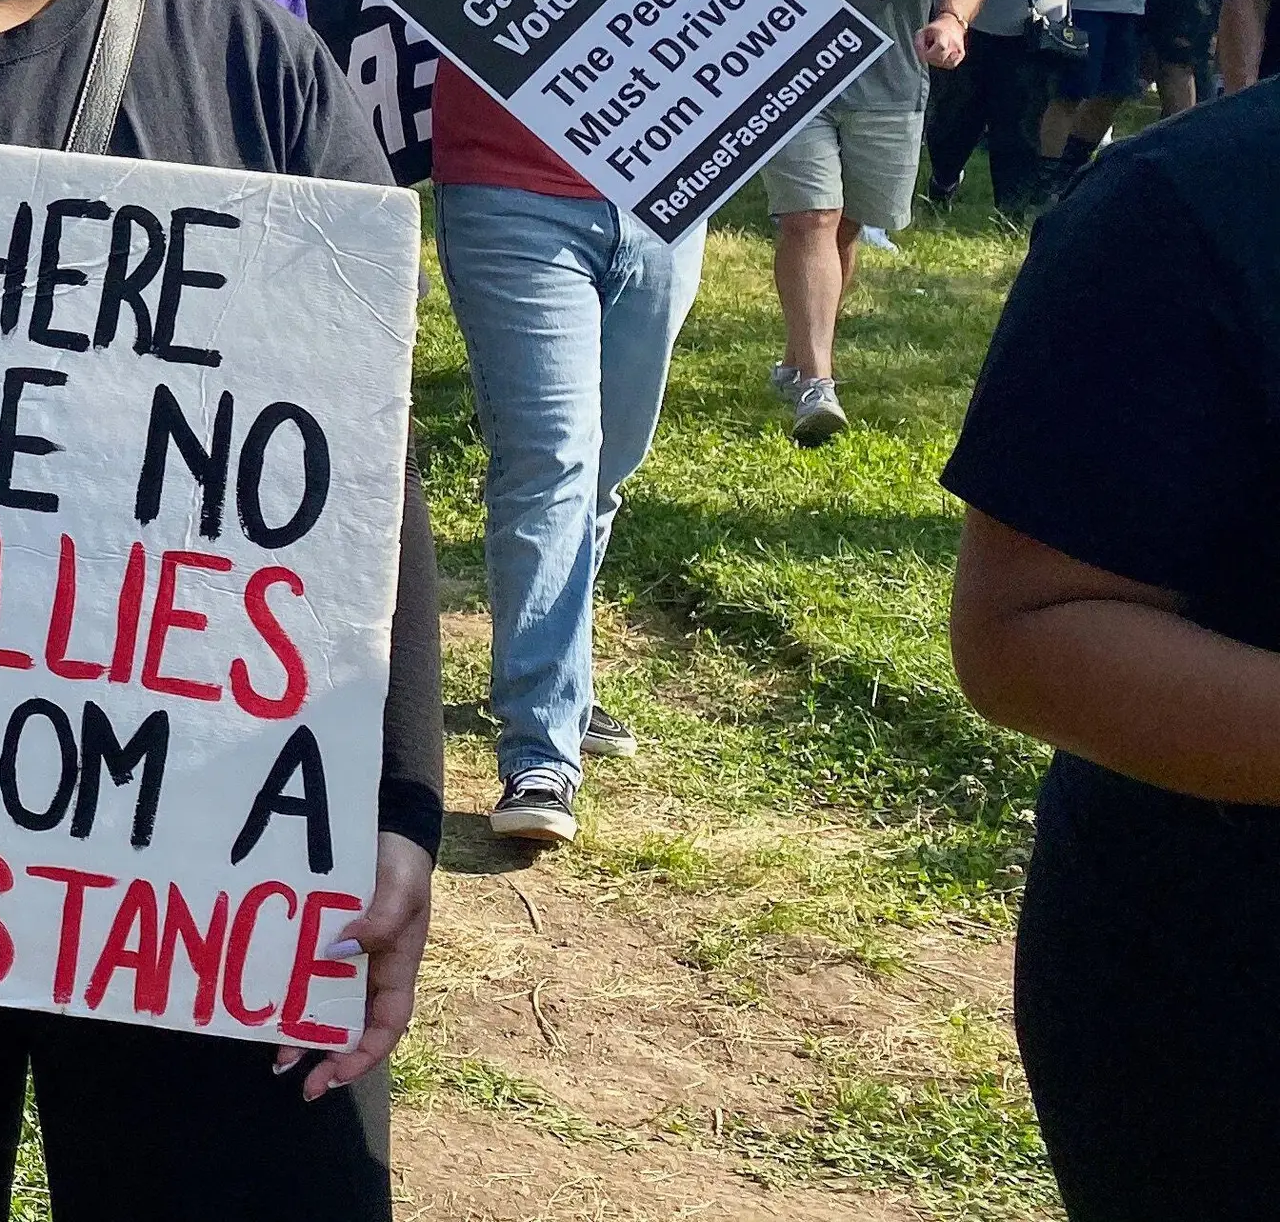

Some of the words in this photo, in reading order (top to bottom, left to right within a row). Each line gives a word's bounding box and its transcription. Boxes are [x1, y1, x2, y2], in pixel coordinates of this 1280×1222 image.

[541, 45, 615, 107] The
[564, 66, 661, 156] Must
[650, 27, 864, 225] RefuseFascism.org
[605, 95, 705, 183] From
[135, 383, 331, 549] NO
[231, 724, 334, 875] A
